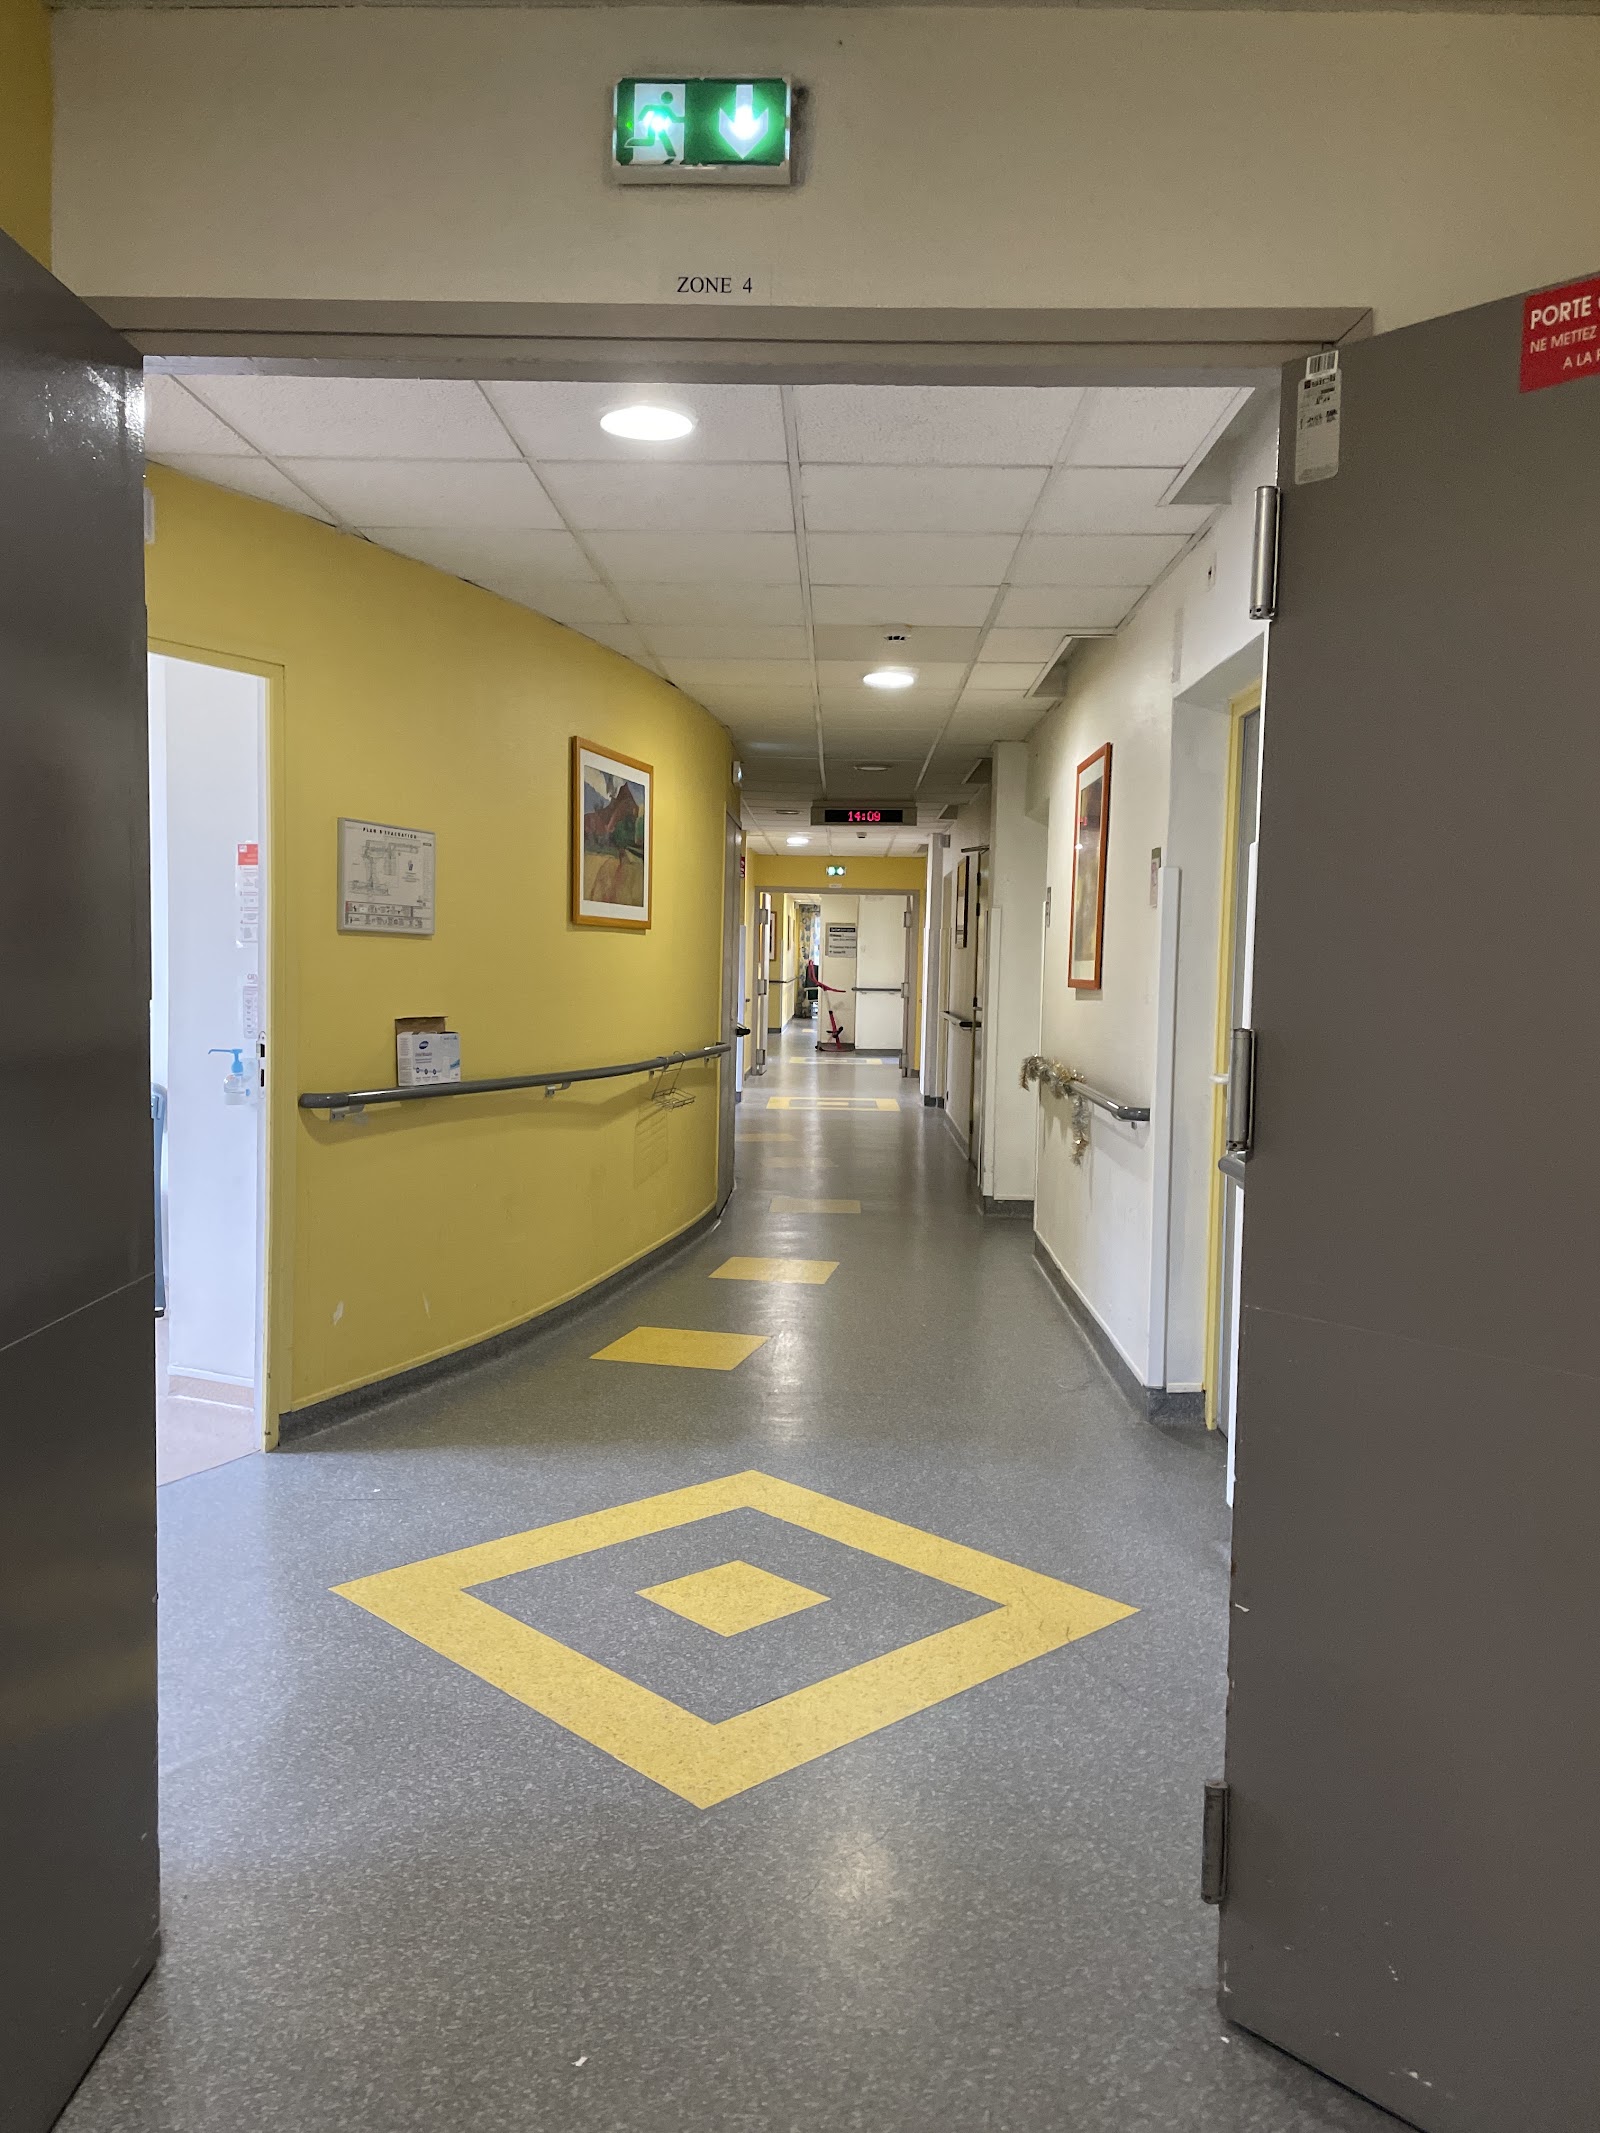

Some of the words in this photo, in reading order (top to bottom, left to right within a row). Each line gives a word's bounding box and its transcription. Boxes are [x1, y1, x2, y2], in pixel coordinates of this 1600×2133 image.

[677, 276, 732, 294] ZONE
[742, 277, 753, 294] 4
[1530, 295, 1592, 330] PORTE
[1529, 337, 1547, 354] NE
[1550, 325, 1598, 349] METTEZ
[1562, 356, 1573, 370] A
[1576, 351, 1592, 367] LA
[847, 810, 881, 822] 14:09
